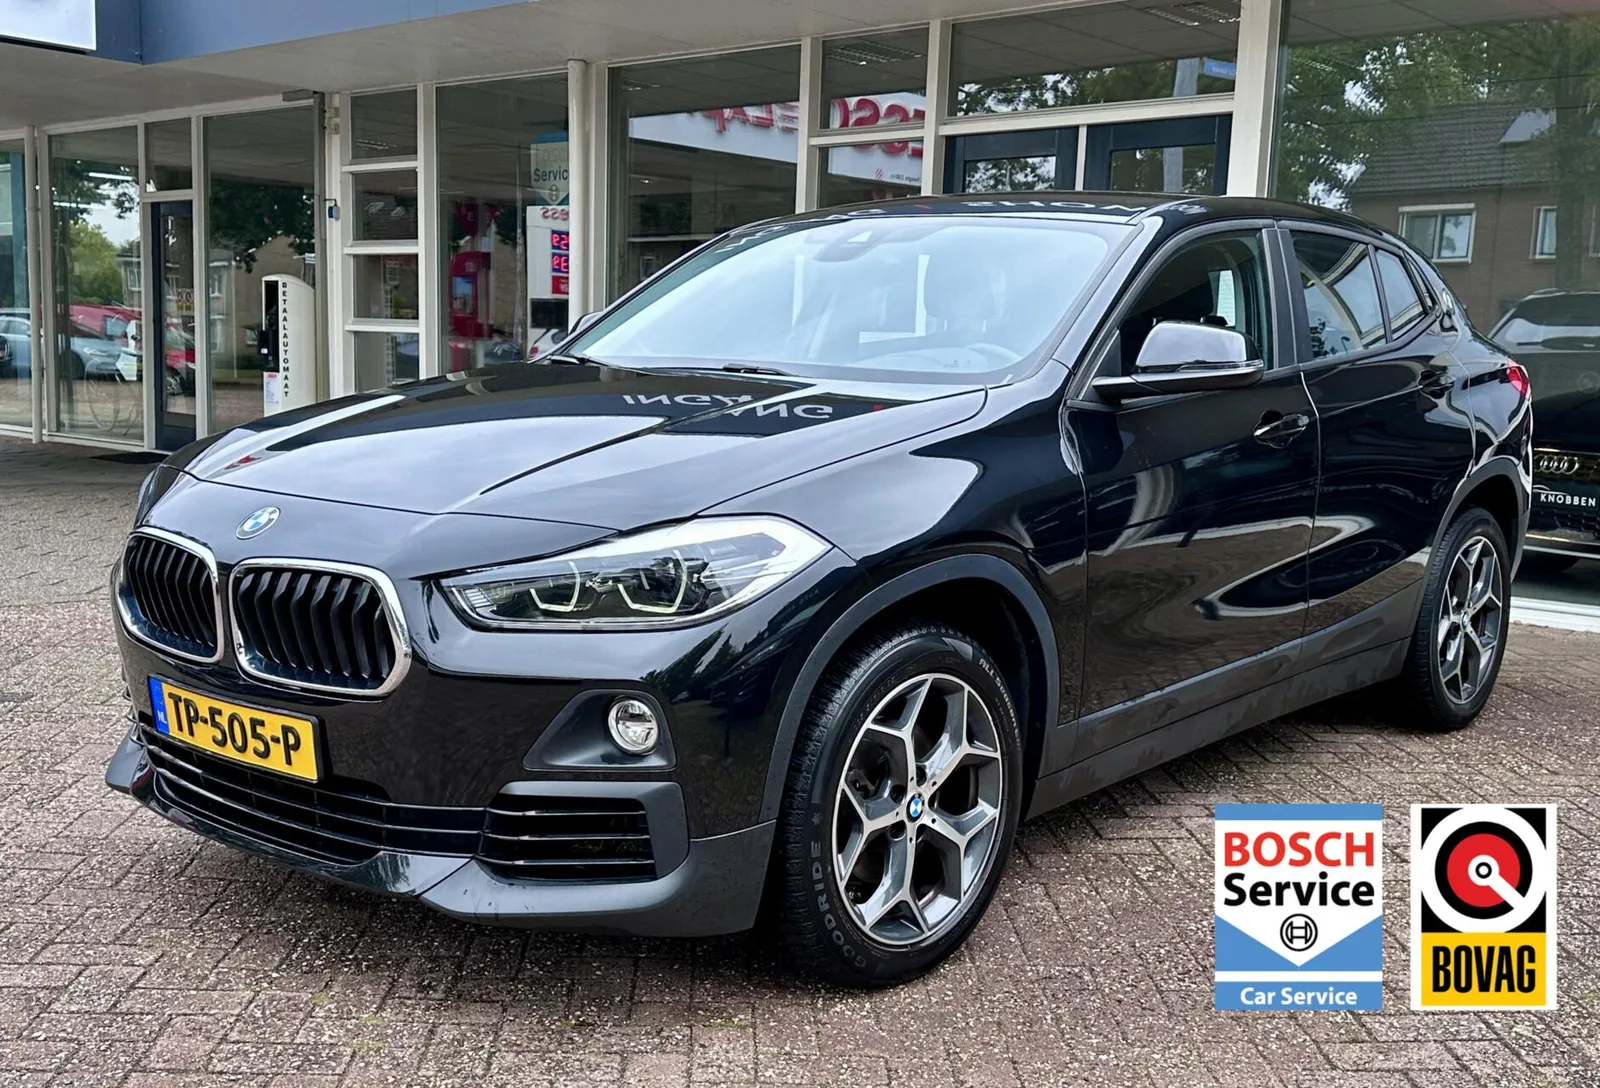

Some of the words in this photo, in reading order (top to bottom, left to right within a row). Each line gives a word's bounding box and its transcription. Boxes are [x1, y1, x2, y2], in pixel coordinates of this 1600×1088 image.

[533, 166, 569, 182] Servic
[281, 281, 289, 398] BETAALAUTOMAAT
[1540, 493, 1596, 507] KNOBBEN
[168, 691, 301, 766] TP-505-P
[810, 840, 867, 968] GOODRIDE
